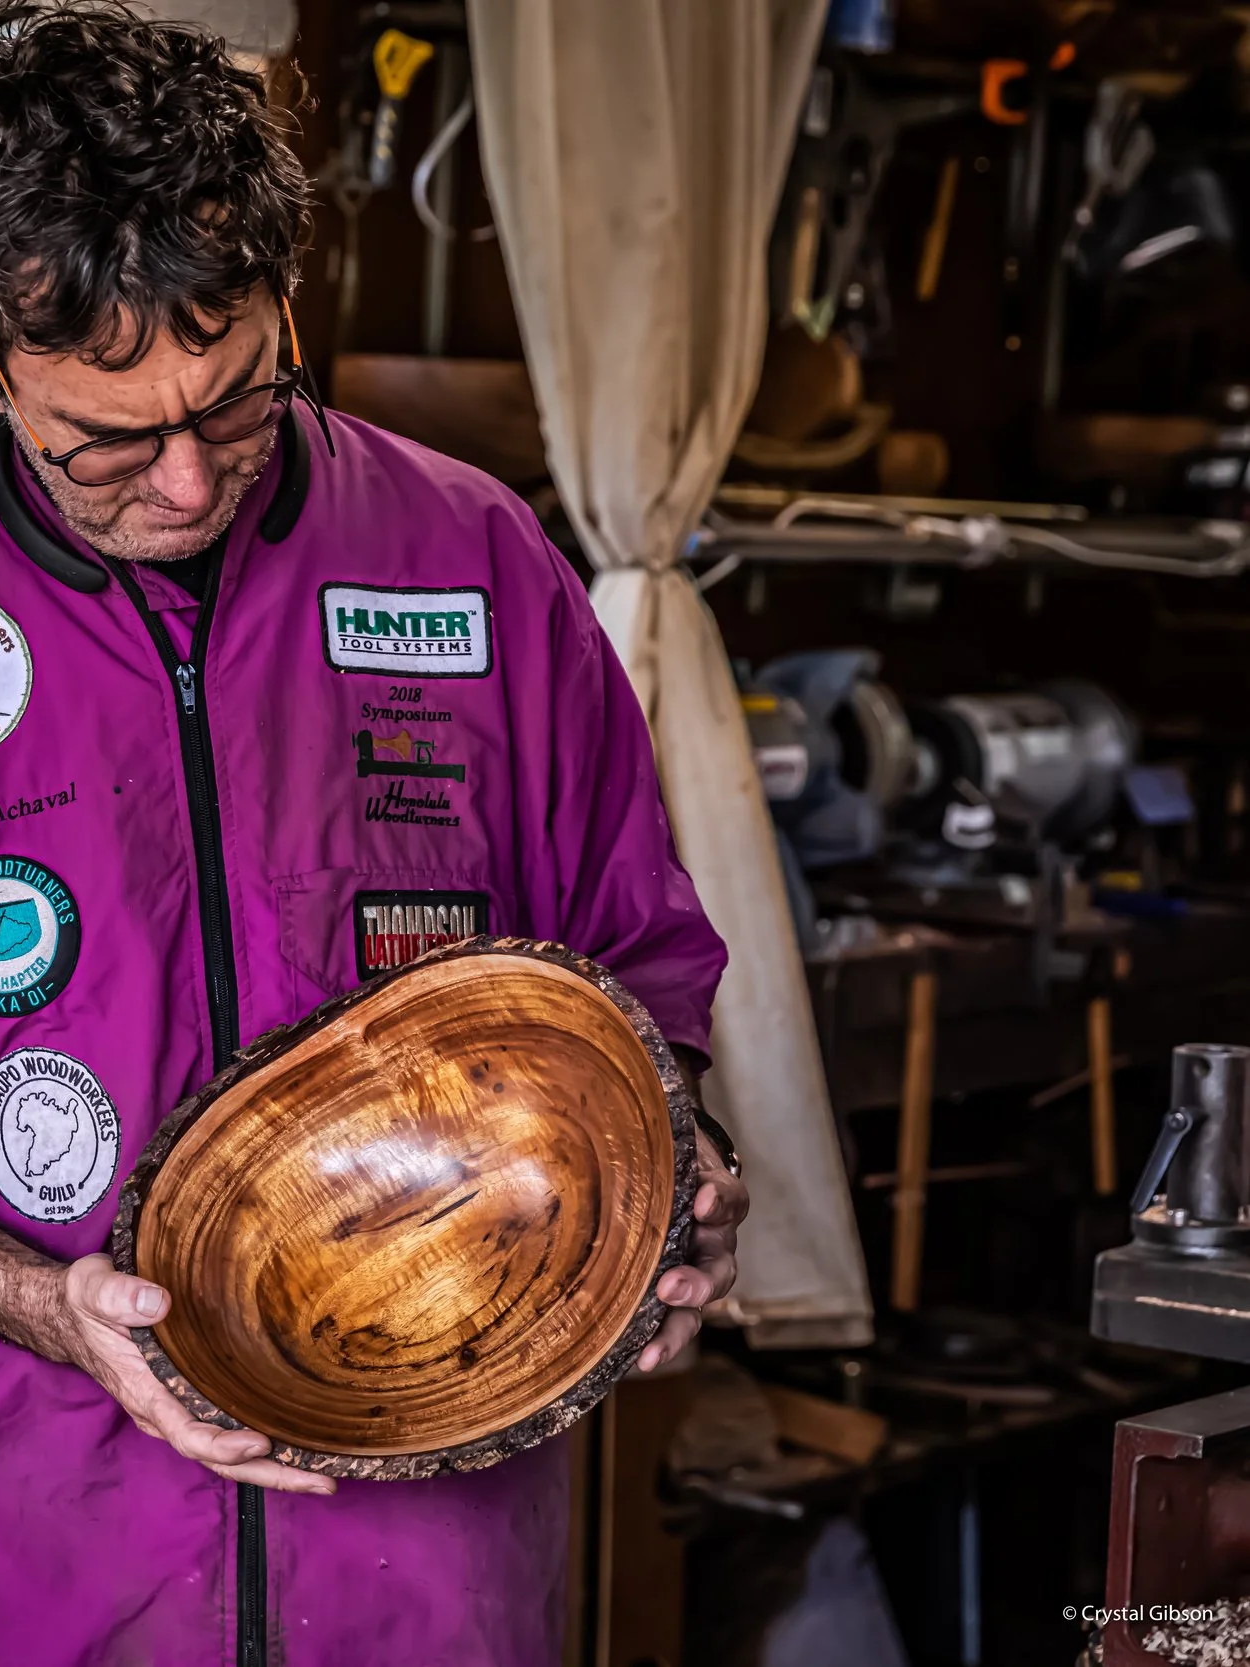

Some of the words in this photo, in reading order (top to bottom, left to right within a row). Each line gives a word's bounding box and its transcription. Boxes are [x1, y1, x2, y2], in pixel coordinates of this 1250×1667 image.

[336, 607, 471, 638] HUNTER
[340, 637, 383, 651] TOOL
[393, 641, 472, 653] SYSTEMS
[388, 686, 423, 703] 2018
[361, 703, 453, 724] Symposium
[384, 780, 451, 810] Honolulu
[365, 797, 460, 827] Woodturners
[20, 1057, 118, 1142] WOODWORKERS
[39, 1183, 76, 1203] GUILD
